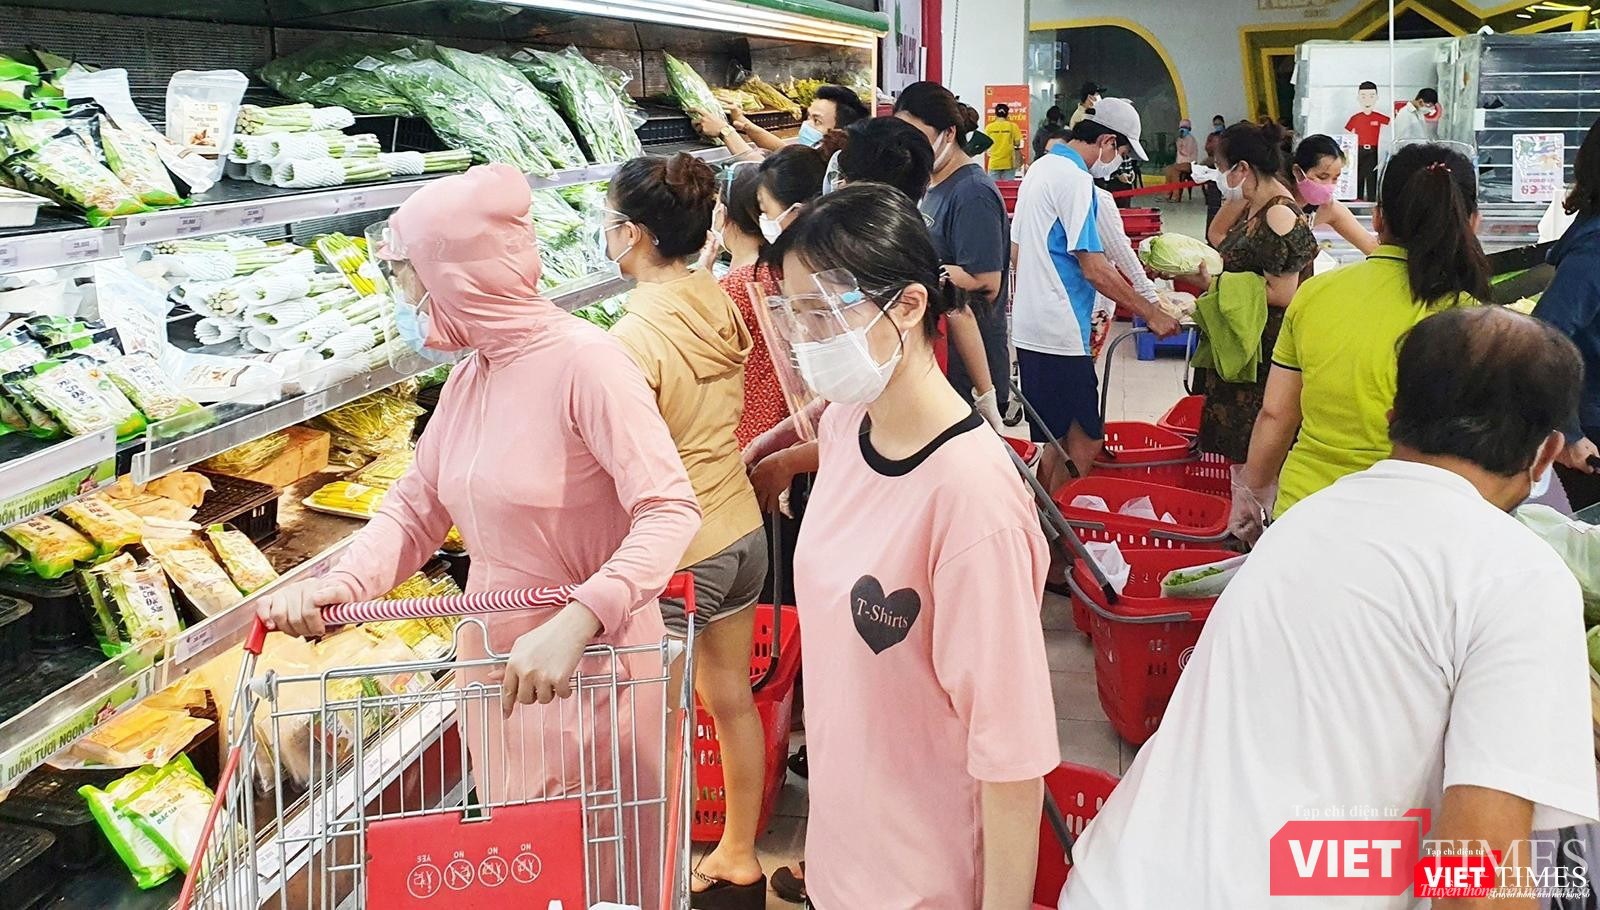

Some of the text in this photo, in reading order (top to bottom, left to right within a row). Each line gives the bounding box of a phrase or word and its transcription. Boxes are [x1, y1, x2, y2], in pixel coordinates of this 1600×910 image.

[857, 598, 908, 628] T-Shirts
[488, 847, 498, 855] NO
[520, 843, 531, 851] NO
[416, 854, 431, 863] YES
[453, 851, 464, 859] NO
